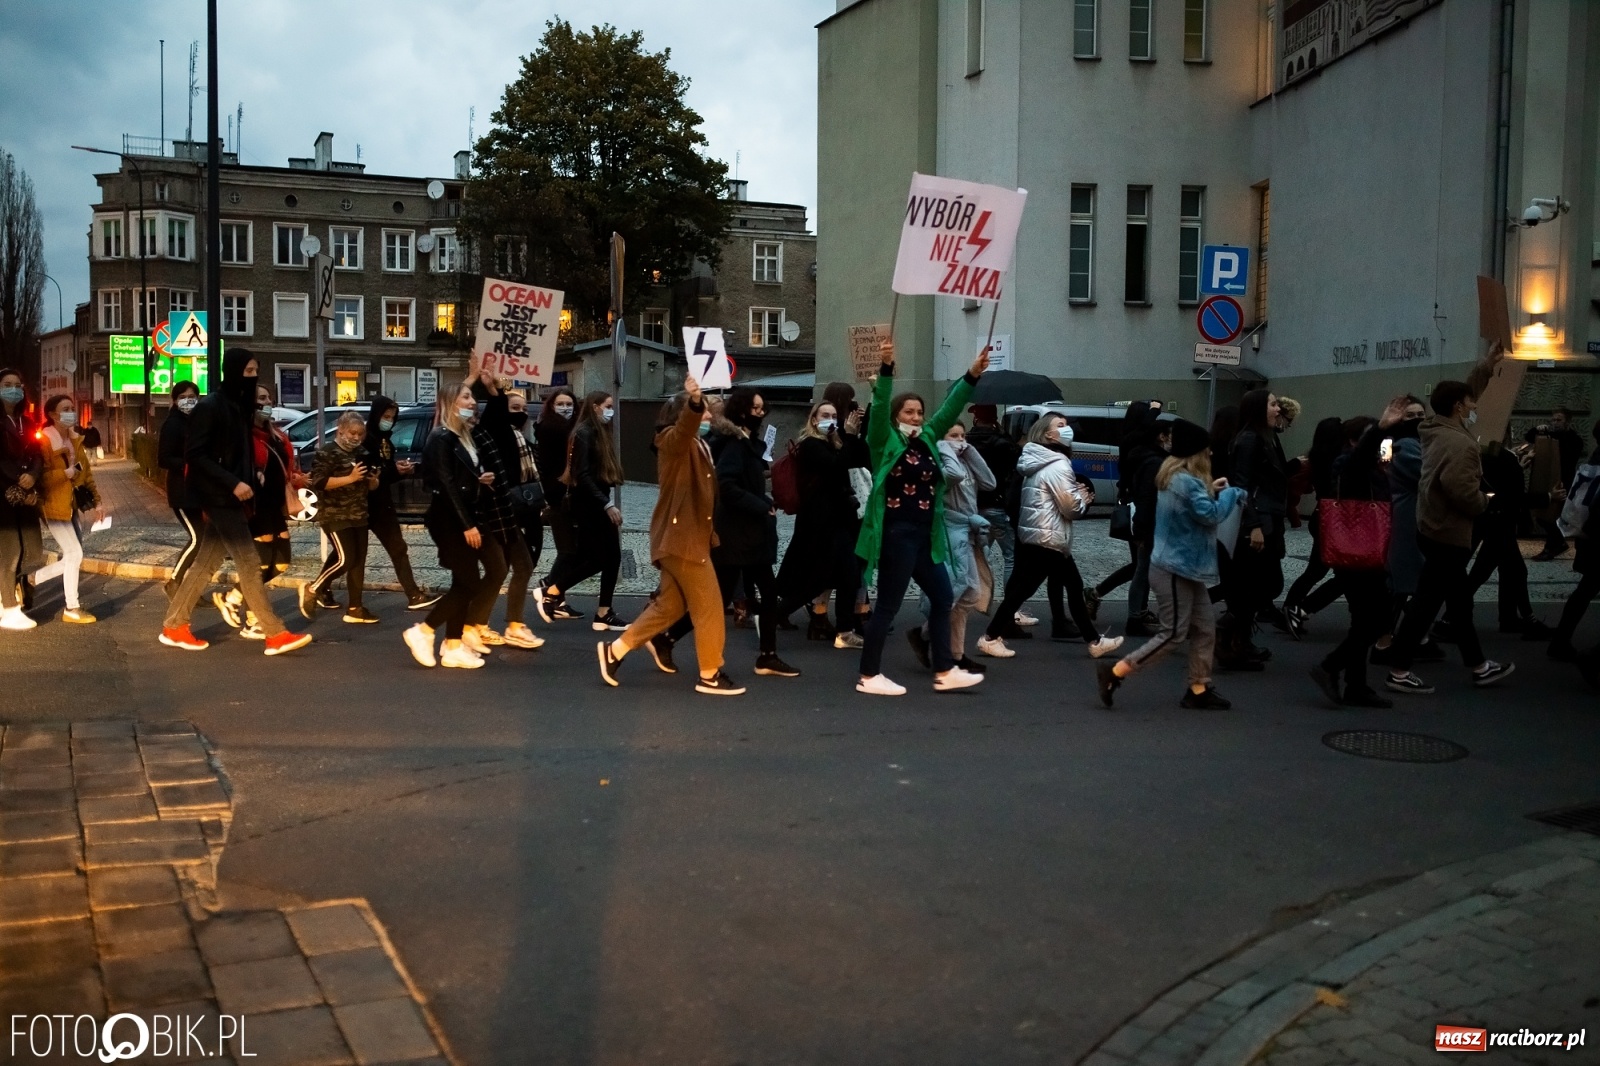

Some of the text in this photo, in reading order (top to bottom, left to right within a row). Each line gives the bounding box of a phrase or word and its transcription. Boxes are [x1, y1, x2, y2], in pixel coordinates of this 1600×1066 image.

[906, 195, 976, 232] WYBÓR
[929, 233, 966, 263] NIE
[938, 263, 1003, 300] ZAKA
[1212, 251, 1239, 289] P
[489, 283, 553, 309] OCEAN
[483, 318, 547, 336] CZYSTSZY
[501, 303, 537, 322] JEST
